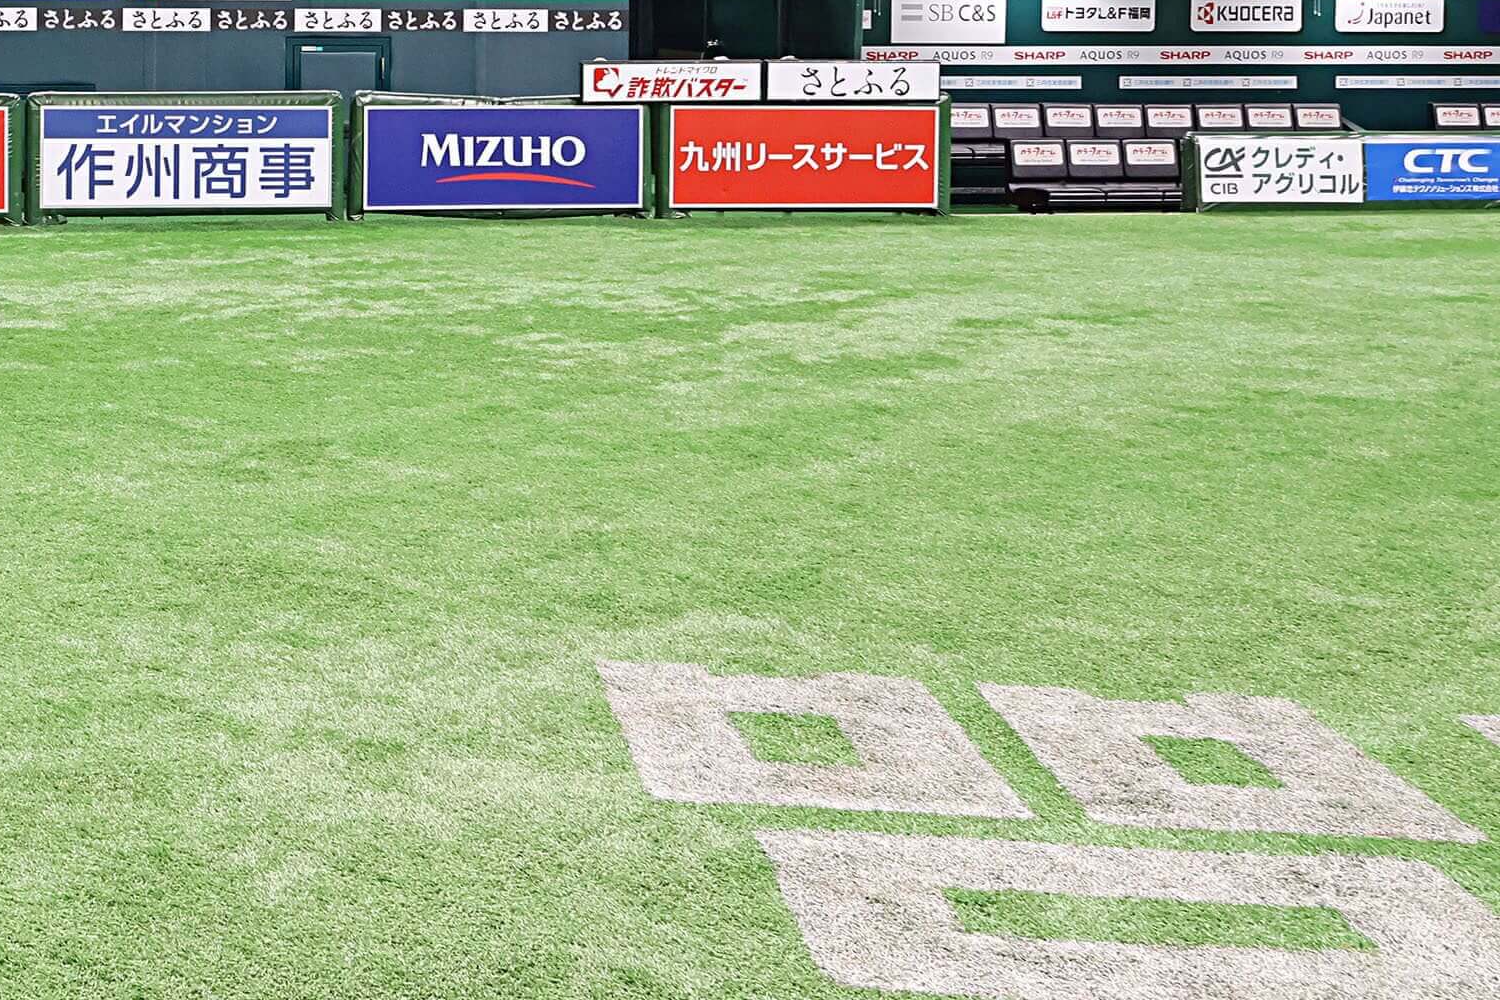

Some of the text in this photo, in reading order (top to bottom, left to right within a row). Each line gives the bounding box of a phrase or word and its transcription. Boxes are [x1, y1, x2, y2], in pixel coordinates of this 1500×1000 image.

[43, 8, 117, 29] さとふる
[132, 10, 202, 29] さとふる
[217, 9, 289, 30] さとふる
[304, 10, 373, 30] さとふる
[386, 10, 457, 31] さとふる
[473, 11, 541, 30] さとふる
[553, 10, 623, 31] さとふる
[928, 3, 997, 22] SB C&S
[1065, 7, 1151, 20] トヨタL&F福岡
[1216, 5, 1295, 22] KYOCERA
[1366, 7, 1432, 28] Japanet
[866, 50, 918, 60] SHARP
[933, 50, 976, 61] AQUOS
[1014, 50, 1066, 60] SHARP
[1079, 50, 1123, 61] AQUOS
[1160, 50, 1211, 60] SHARP
[1224, 50, 1267, 61] AQUOS
[1303, 50, 1354, 60] SHARP
[1366, 50, 1408, 61] AQUOS
[1443, 50, 1493, 60] SHARP
[626, 77, 749, 99] 詐欺バスター
[800, 66, 911, 97] さとふる
[96, 114, 279, 135] エイルマンション
[420, 133, 586, 168] MIZUHO
[678, 141, 930, 173] 九州リースサービス
[57, 143, 316, 200] 作州商事
[1403, 149, 1493, 174] CTC
[1209, 182, 1239, 195] CIB
[1252, 173, 1360, 195] アグリコル
